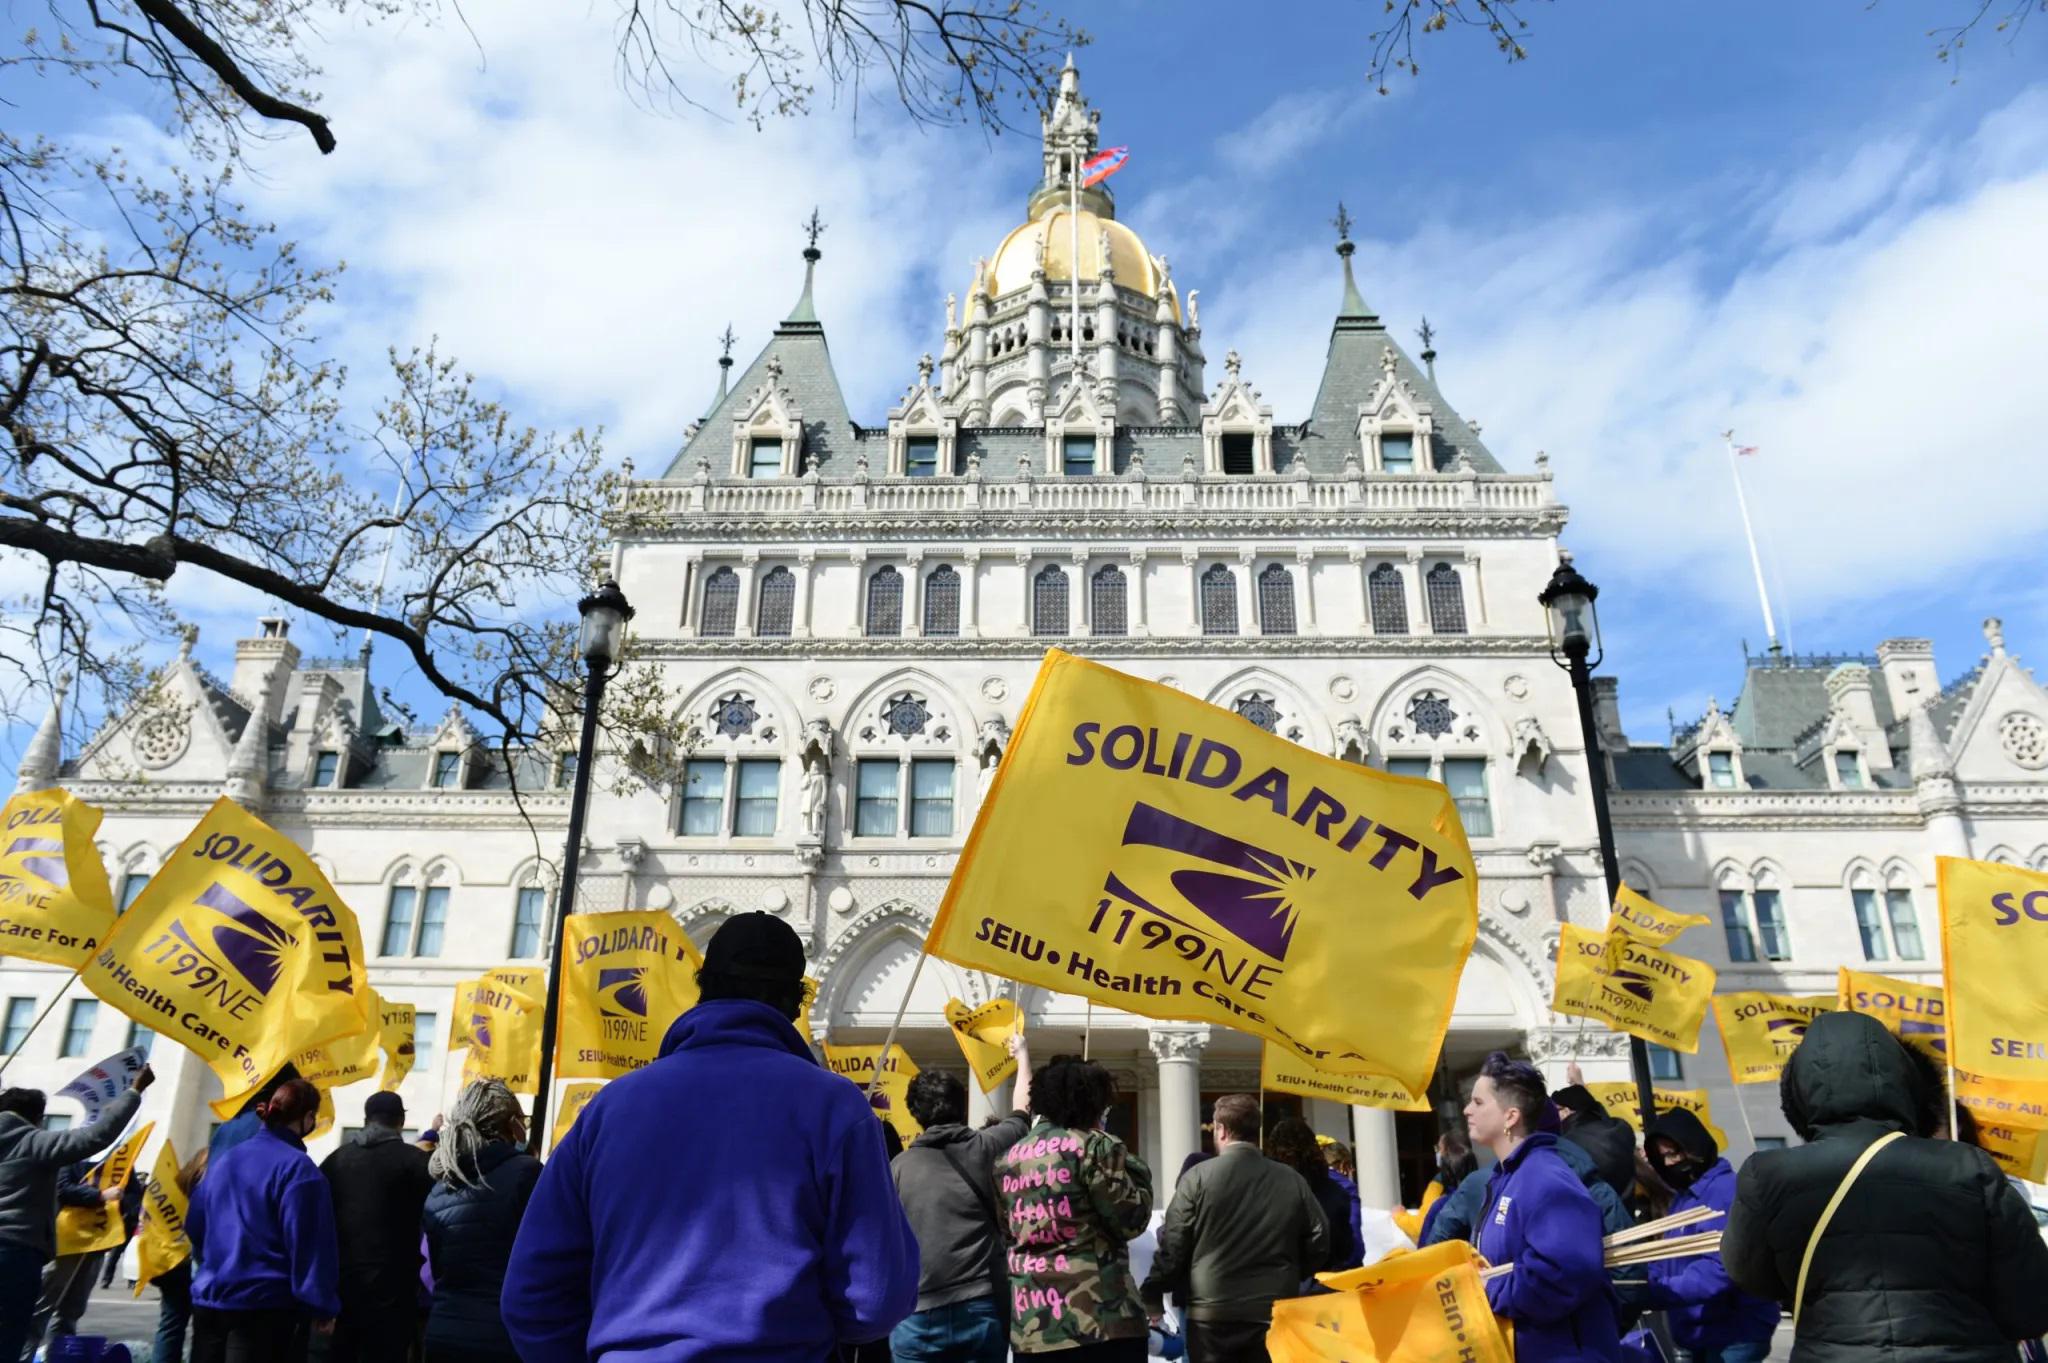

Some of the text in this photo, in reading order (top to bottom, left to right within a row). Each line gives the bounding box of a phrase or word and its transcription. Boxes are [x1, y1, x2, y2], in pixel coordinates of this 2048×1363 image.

[1066, 722, 1464, 900] SOLIDARITY
[193, 832, 354, 996] SOLIDARITY
[47, 928, 79, 949] For
[1088, 898, 1283, 1000] 1199NE
[143, 934, 263, 1020] 1199NE
[1066, 951, 1181, 995] Health
[1192, 980, 1266, 1024] Care
[1600, 990, 1650, 1015] 1199NE
[111, 963, 177, 1018] Health
[180, 1009, 231, 1051] Care
[232, 1044, 256, 1072] For
[602, 1018, 648, 1042] 1199NE
[1308, 1079, 1344, 1094] Health
[1346, 1085, 1371, 1098] Care
[1372, 1089, 1389, 1100] For
[1605, 1089, 1703, 1112] SOLIARITY
[1985, 1098, 2015, 1111] For
[1046, 1162, 1072, 1187] be
[1006, 1249, 1071, 1274] like a
